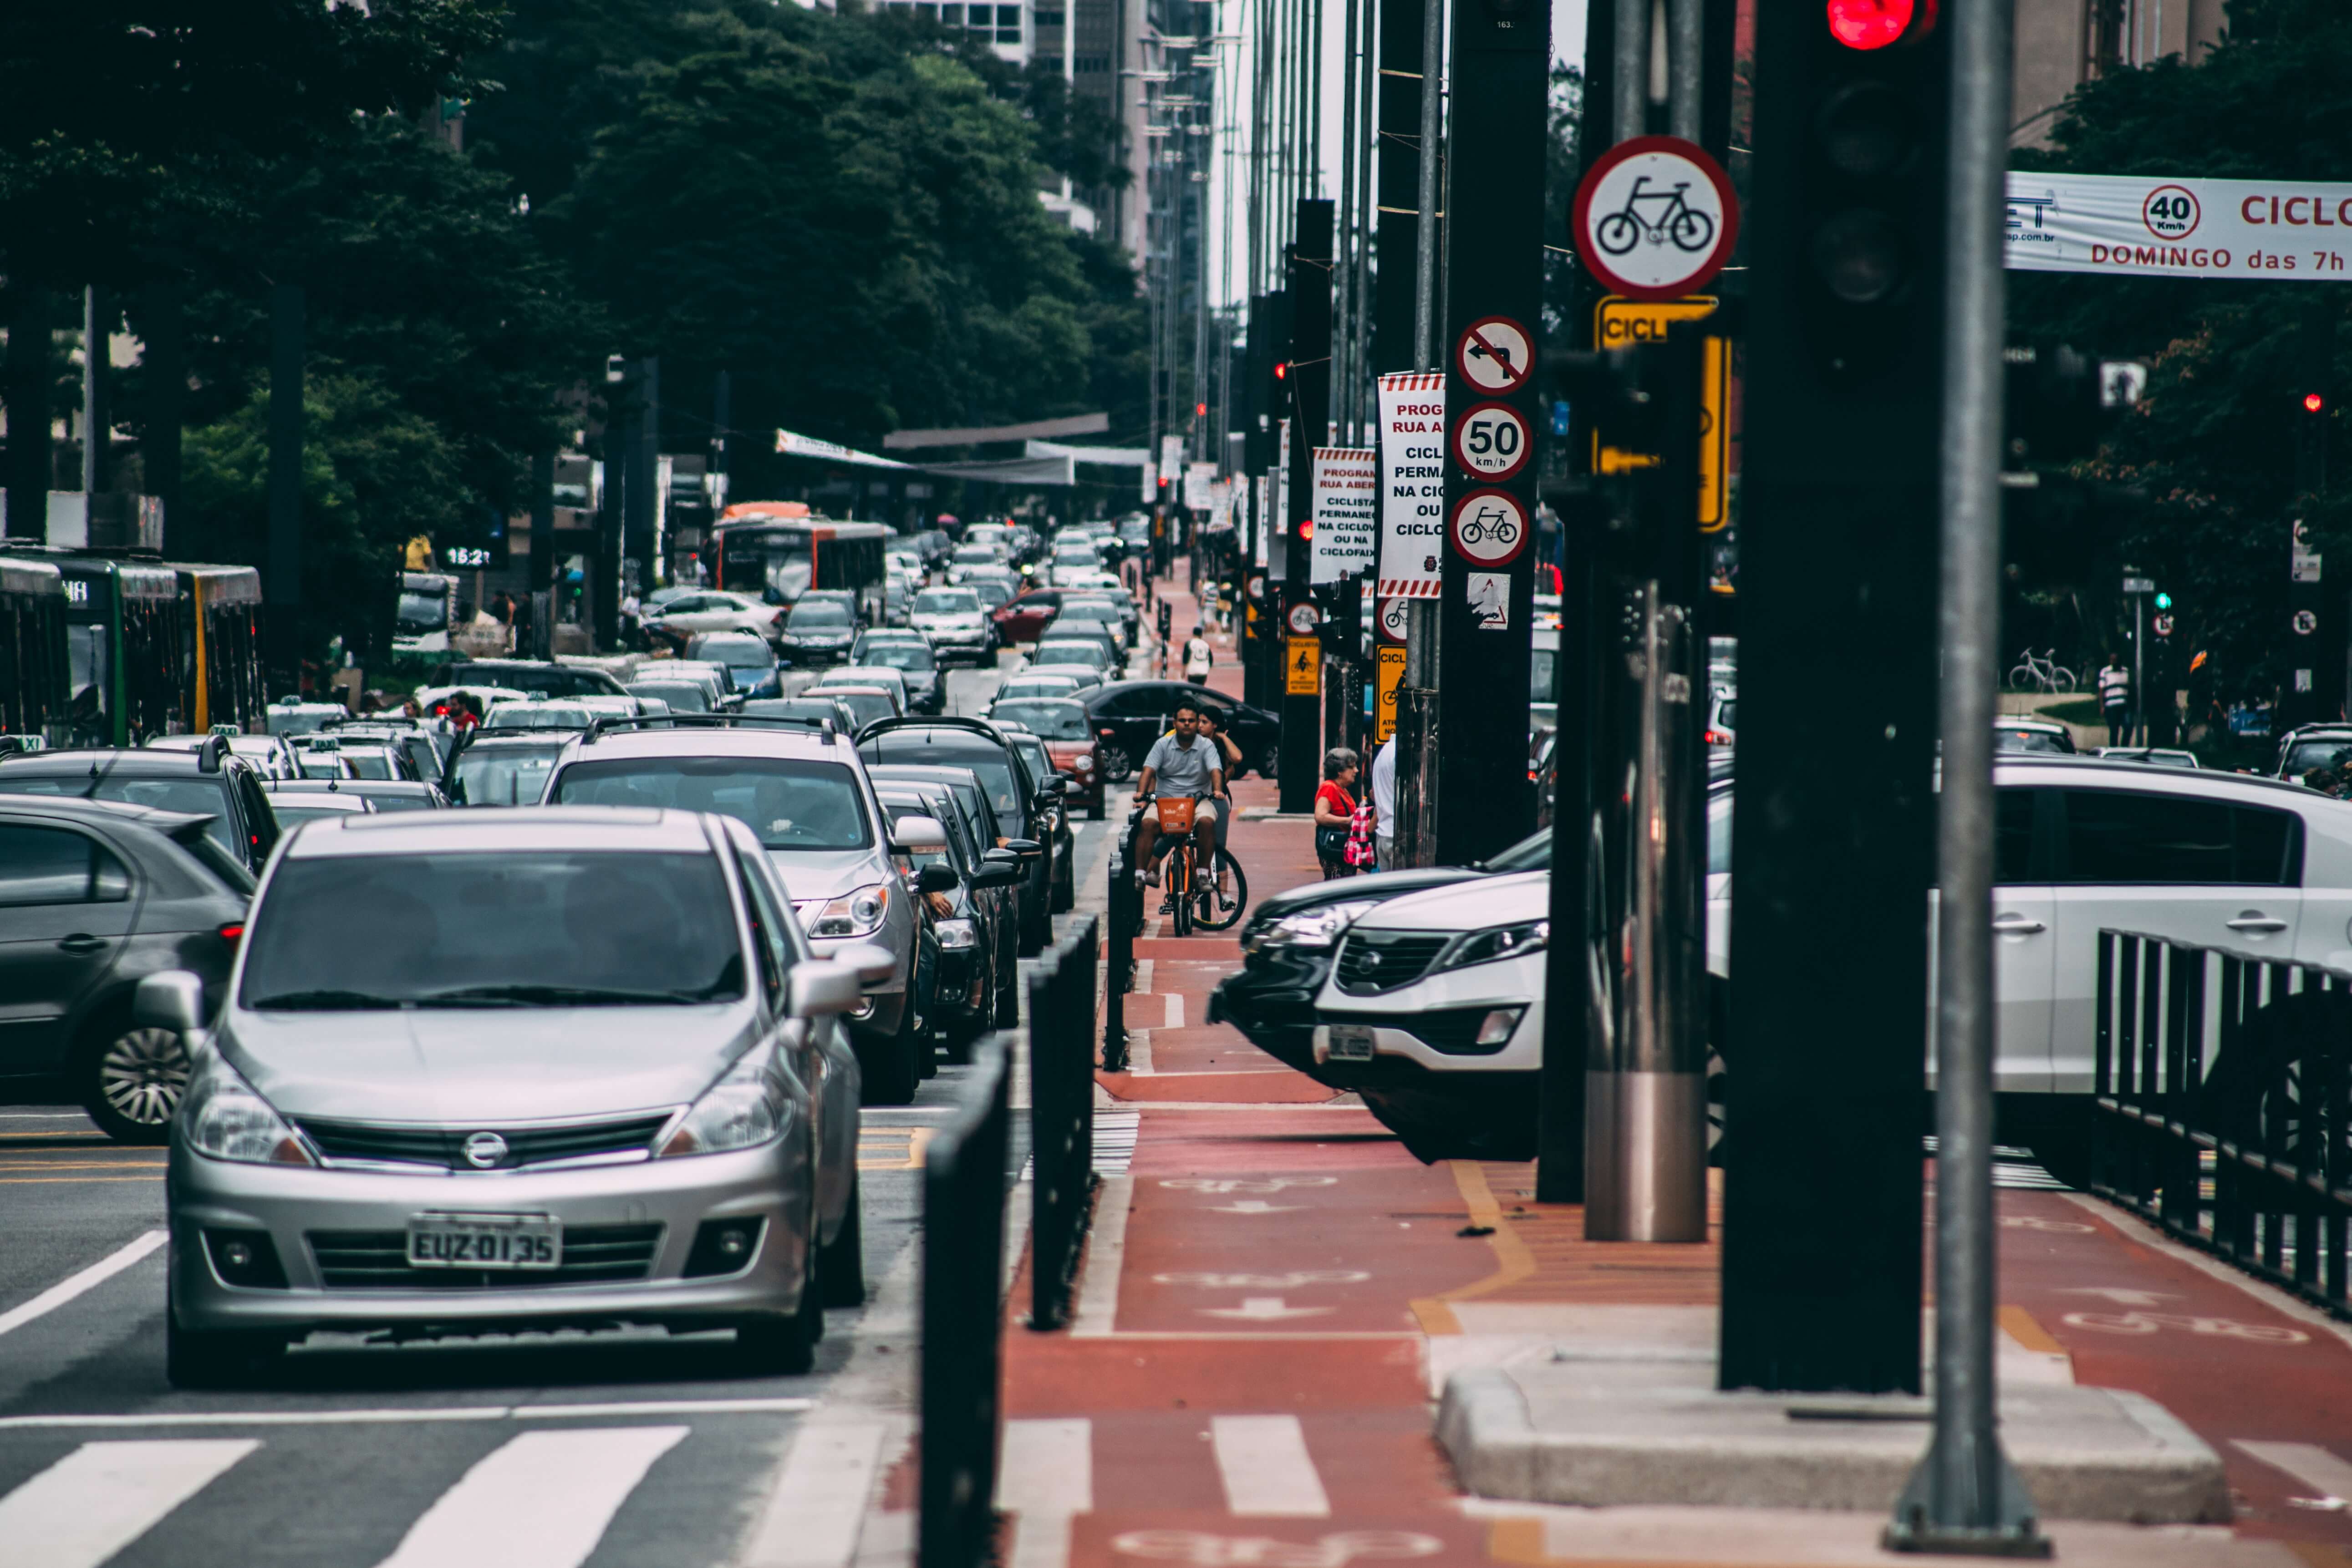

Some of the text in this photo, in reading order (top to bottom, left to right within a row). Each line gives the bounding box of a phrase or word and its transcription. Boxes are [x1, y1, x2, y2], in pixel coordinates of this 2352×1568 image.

[2150, 196, 2190, 219] 40
[2158, 221, 2185, 231] Km/h
[2092, 244, 2344, 270] DOMINGO das 7h
[1393, 422, 1444, 432] RUA A
[1468, 421, 1519, 455] 50
[1406, 448, 1443, 458] CICL
[1476, 457, 1506, 468] km/h
[1394, 486, 1416, 497] NA
[1327, 498, 1375, 506] CICLISTA
[1417, 505, 1440, 516] OU
[1396, 524, 1442, 535] CICLO
[1380, 653, 1405, 663] CICL
[214, 727, 237, 735] TAXI
[20, 738, 40, 750] XI
[315, 739, 336, 749] TAXI
